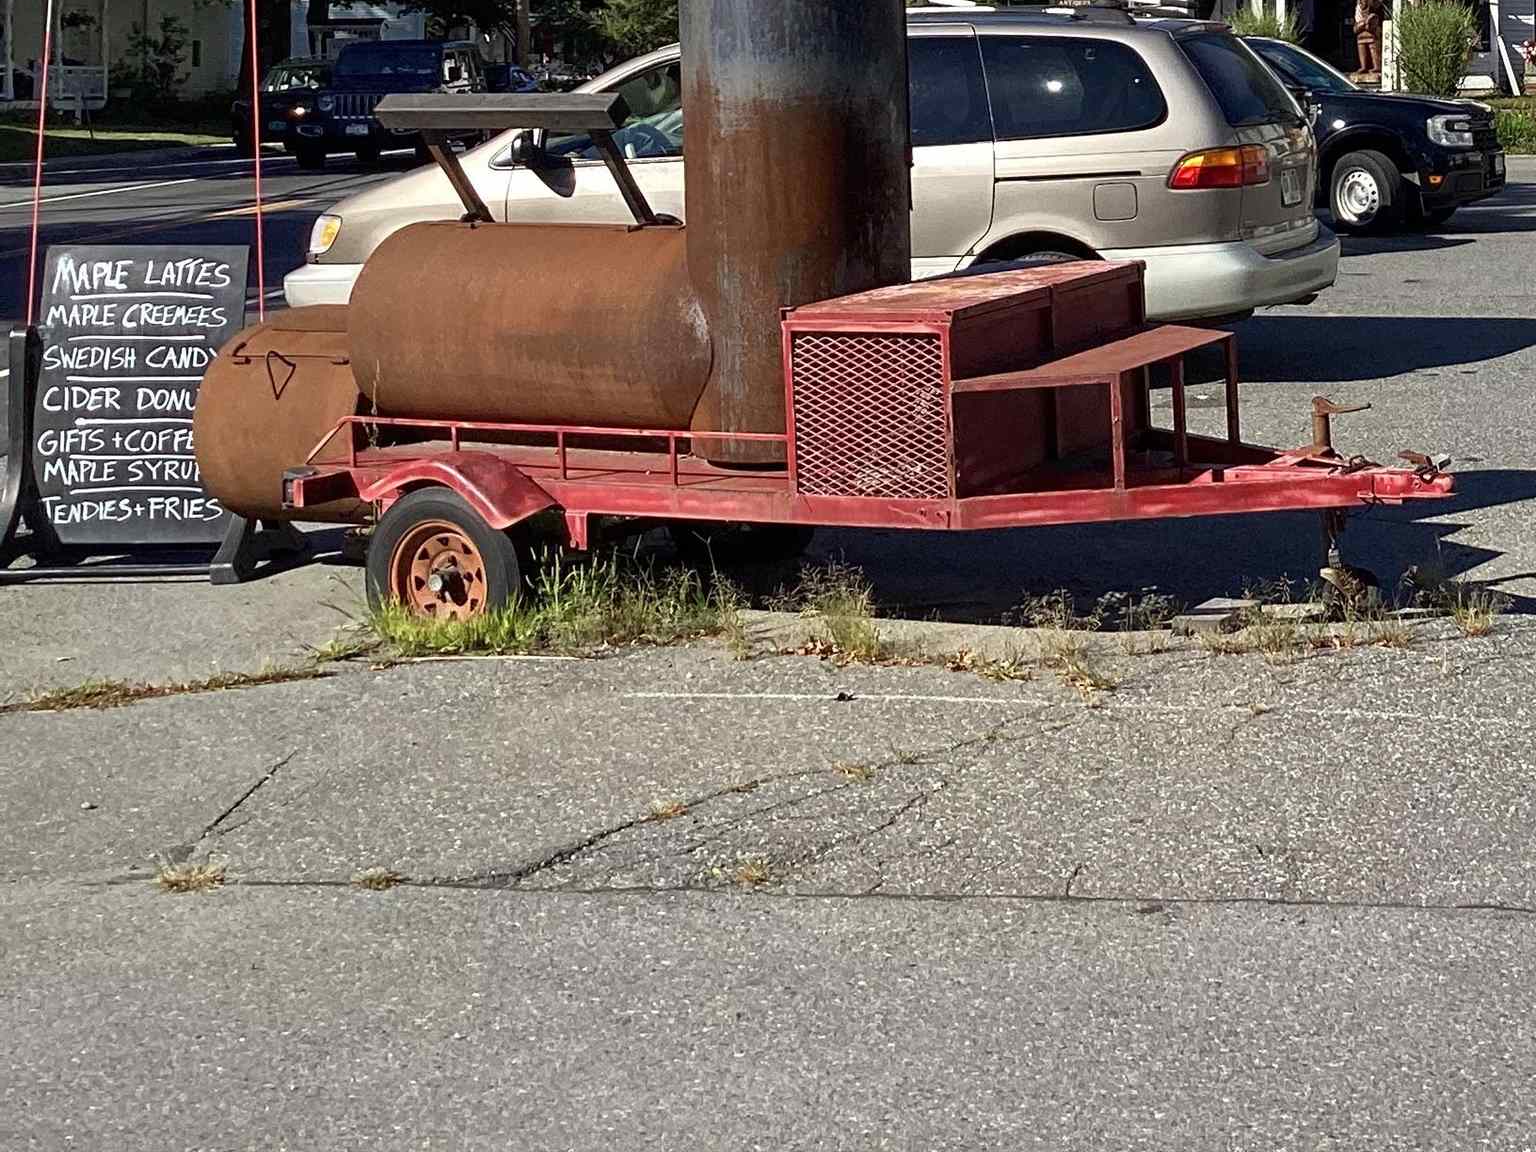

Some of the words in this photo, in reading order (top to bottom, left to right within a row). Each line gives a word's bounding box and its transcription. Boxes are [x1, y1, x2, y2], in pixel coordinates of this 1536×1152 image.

[52, 254, 134, 294] MAPLE
[144, 260, 231, 288] LATTES
[46, 304, 116, 328] MAPLE
[122, 303, 228, 329] CREEMEES
[43, 345, 137, 371] SWEDISH
[42, 387, 121, 412] CIDER
[137, 387, 201, 411] DONU
[37, 429, 105, 456] GIFTS
[44, 460, 115, 484] MAPLE
